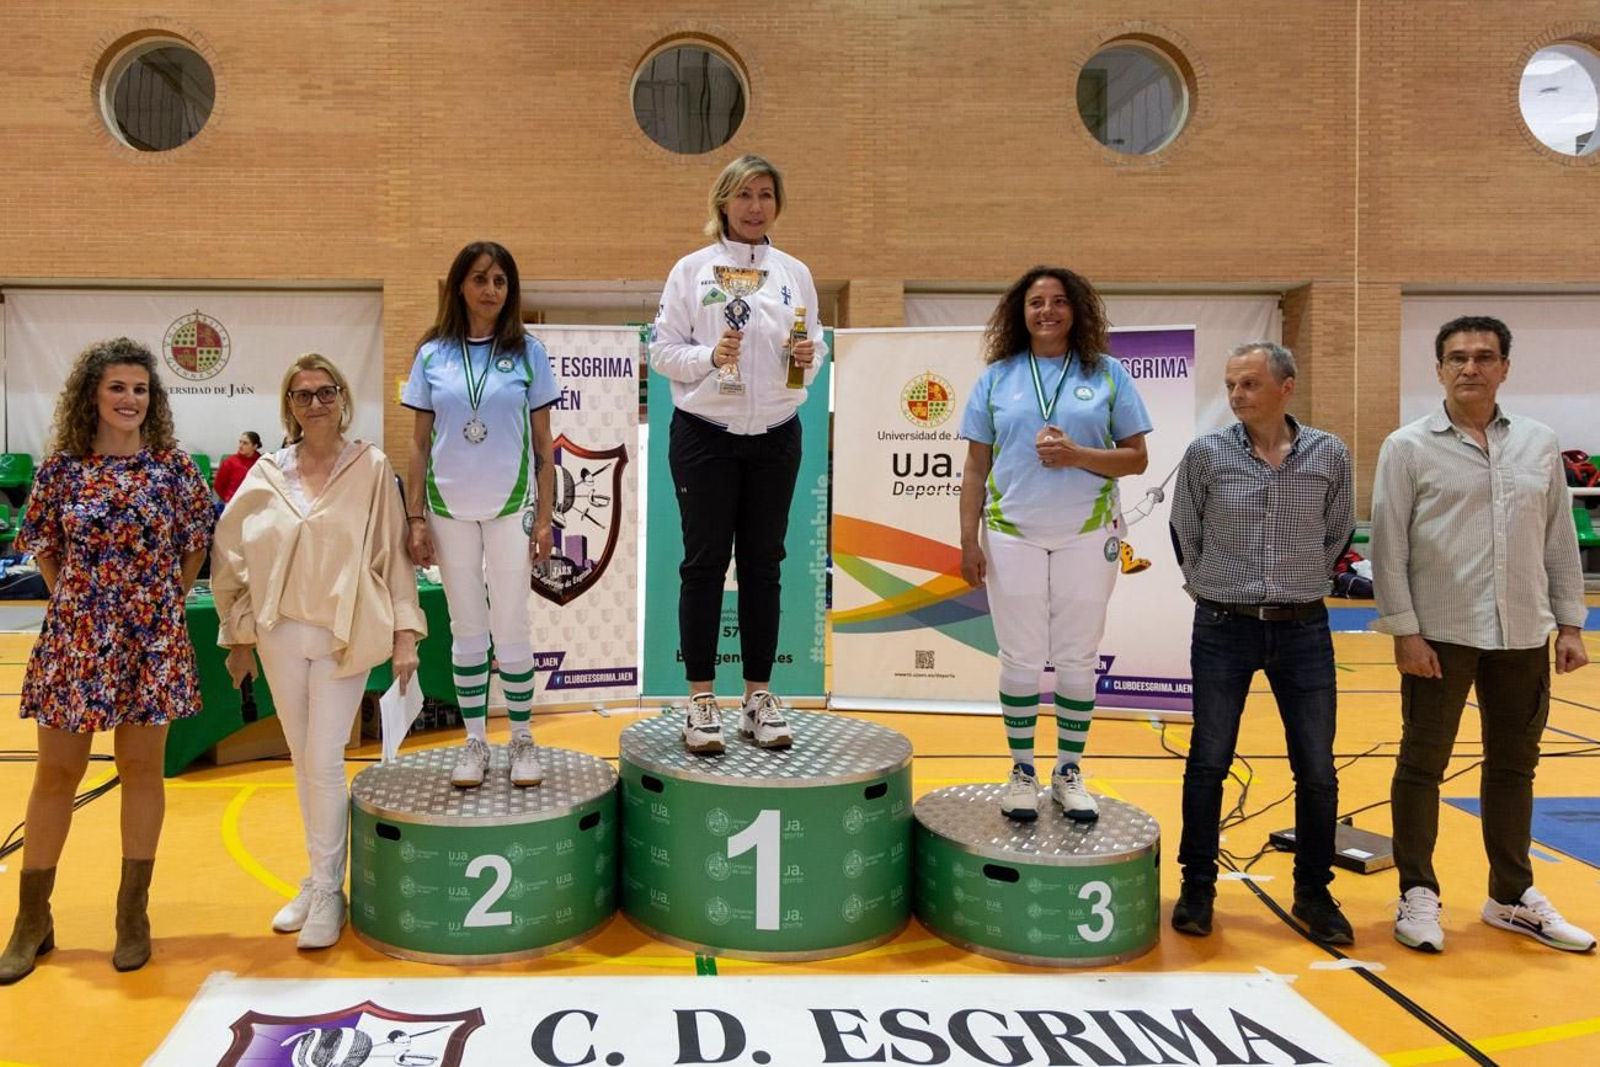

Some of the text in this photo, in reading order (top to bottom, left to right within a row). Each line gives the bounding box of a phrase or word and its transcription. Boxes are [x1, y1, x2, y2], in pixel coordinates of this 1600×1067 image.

[214, 387, 226, 395] DE
[561, 357, 633, 378] ESGRIMA
[877, 431, 937, 441] Universidad
[939, 431, 951, 441] de
[463, 854, 513, 927] 2
[727, 809, 781, 931] 1
[1077, 880, 1115, 943] 3
[531, 1006, 1329, 1067] C. D. ESGRIMA
